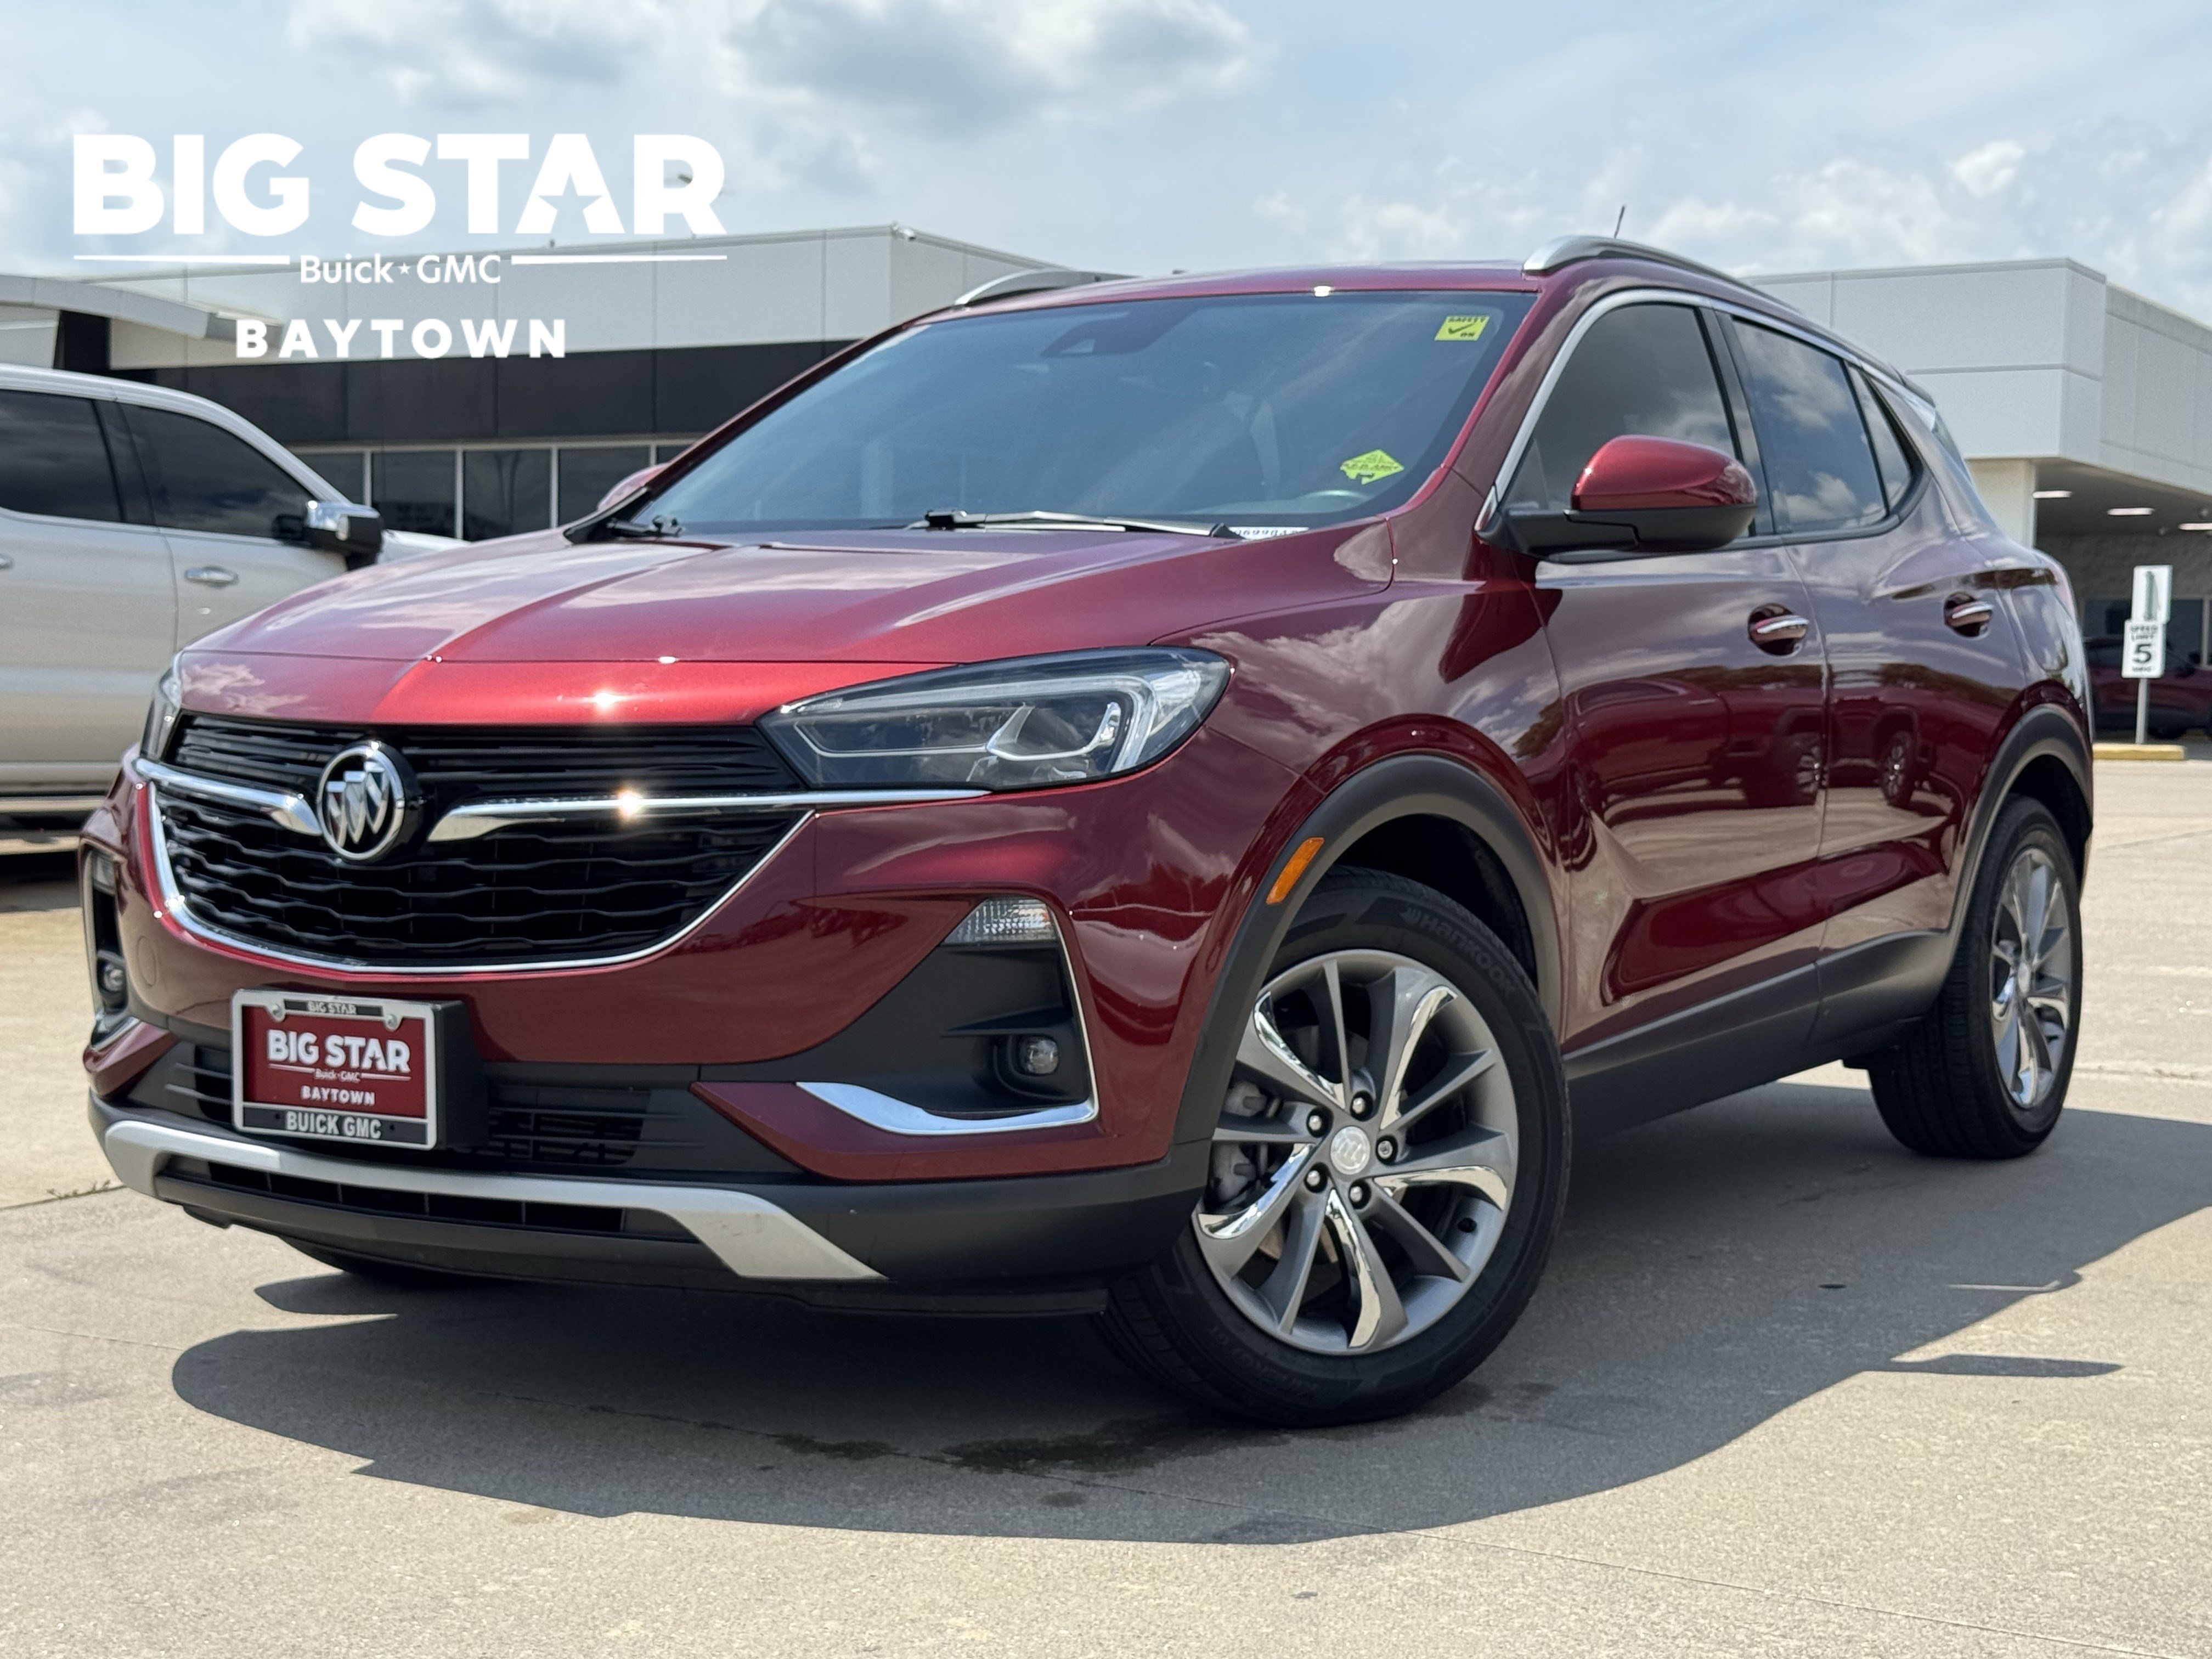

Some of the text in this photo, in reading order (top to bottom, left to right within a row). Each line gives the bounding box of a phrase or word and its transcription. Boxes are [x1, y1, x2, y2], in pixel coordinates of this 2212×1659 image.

[2133, 643, 2152, 664] 5
[308, 1000, 357, 1015] BIG STAR
[267, 1029, 411, 1074] BIG STAR
[301, 1085, 376, 1107] BAYTOWN
[286, 1110, 382, 1139] BUICK GMC
